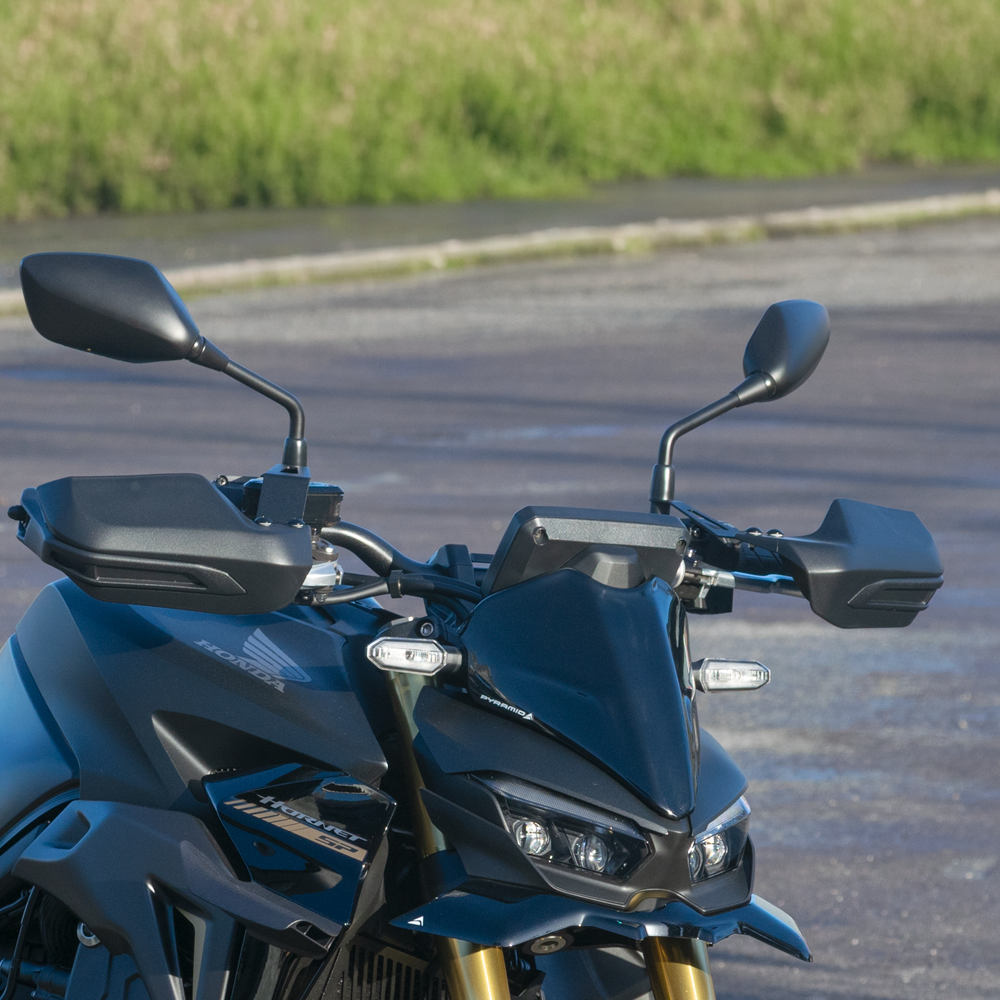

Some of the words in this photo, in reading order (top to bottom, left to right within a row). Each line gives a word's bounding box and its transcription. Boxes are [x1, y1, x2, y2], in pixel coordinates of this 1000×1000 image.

[193, 638, 285, 693] HONDA
[480, 694, 526, 717] PYRAMID
[254, 791, 368, 843] HORNET
[314, 834, 361, 854] SP
